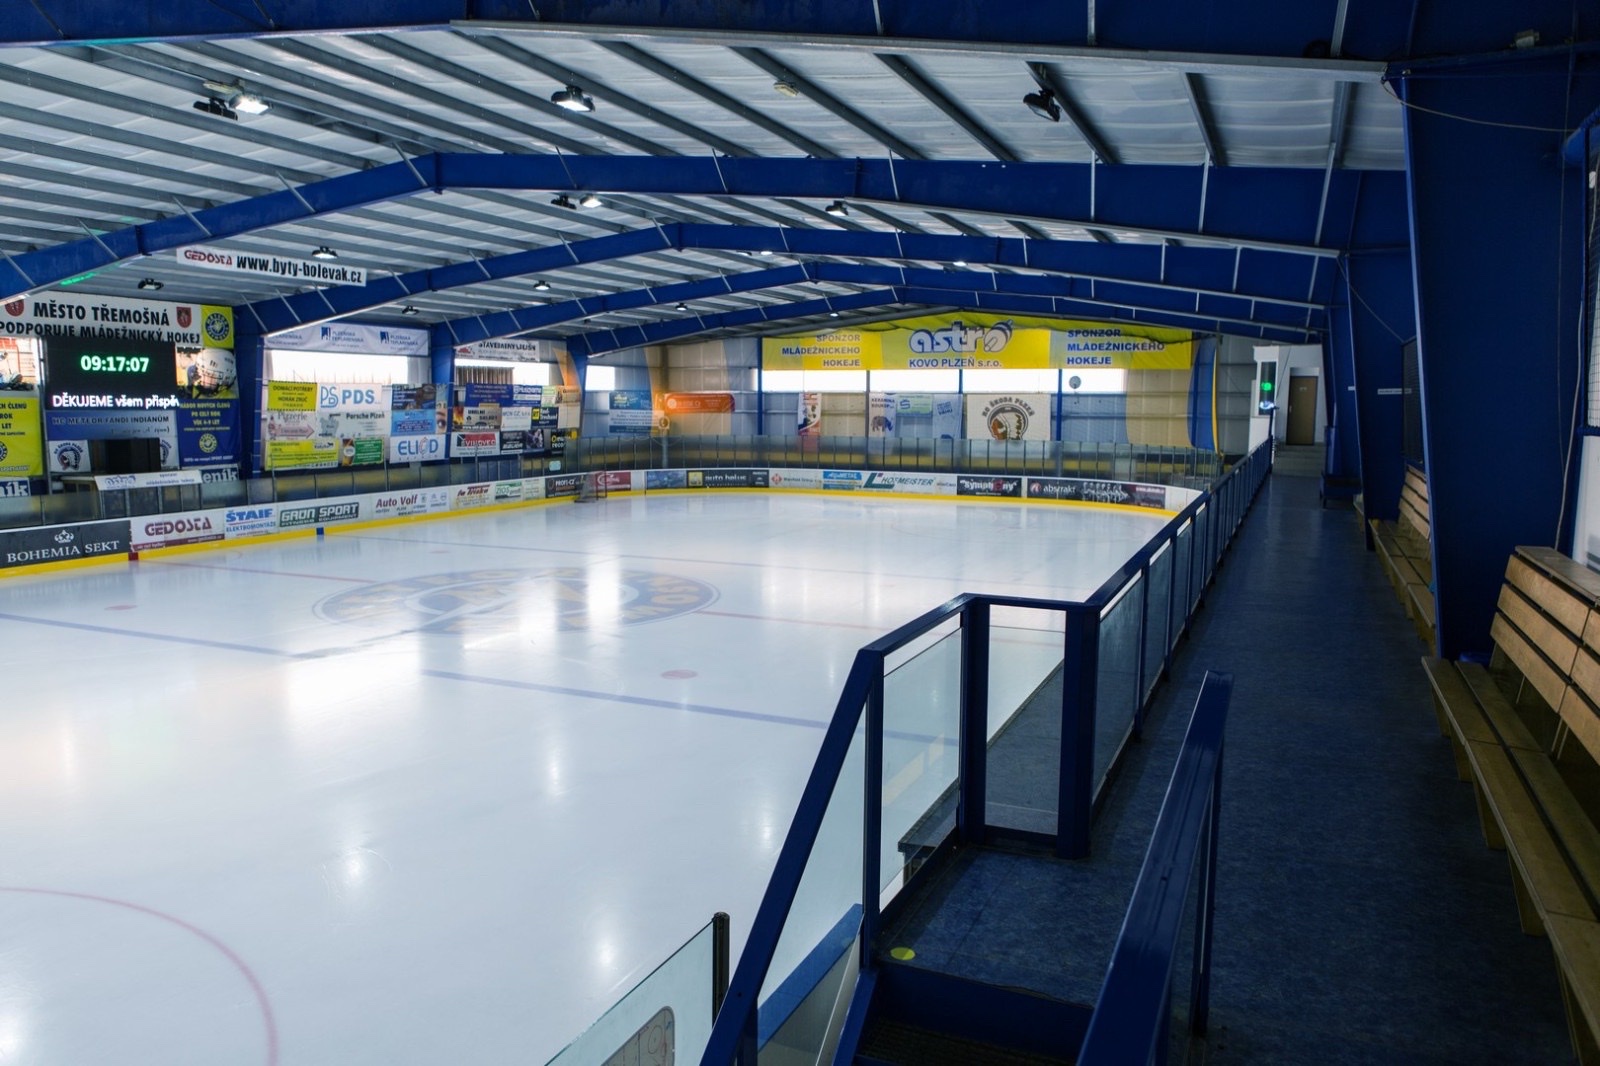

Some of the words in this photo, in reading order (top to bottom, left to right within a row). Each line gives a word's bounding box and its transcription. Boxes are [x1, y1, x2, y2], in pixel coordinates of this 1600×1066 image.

[236, 255, 363, 283] www.byty-bolevak.cz
[33, 300, 86, 321] MĚSTO
[91, 306, 170, 326] TŘEMOŠNÁ
[80, 324, 163, 342] MLÁDEŽNICKÝ
[166, 331, 201, 344] HOKEJ
[816, 333, 861, 343] SPONZOR
[1067, 329, 1122, 338] SPONZOR
[782, 344, 861, 355] MLÁDEŽNICKÉHO
[80, 354, 150, 373] 09:17:07
[823, 358, 861, 367] HOKEJE
[909, 358, 939, 368] KOVO
[941, 356, 975, 368] PLZEŇ
[978, 359, 1002, 368] s.r.o.
[1066, 356, 1112, 365] HOKEJE
[52, 392, 114, 408] DĚKUJEME
[115, 394, 143, 408] všem
[342, 389, 375, 405] PDS
[202, 468, 238, 483] eník
[376, 498, 398, 509] Auto
[400, 493, 418, 506] Volf
[226, 508, 273, 523] ŠTAIF
[319, 503, 359, 517] SPORT
[145, 517, 212, 537] GEDOSTA
[7, 546, 81, 563] BOHEMIA
[85, 540, 119, 555] SEKT
